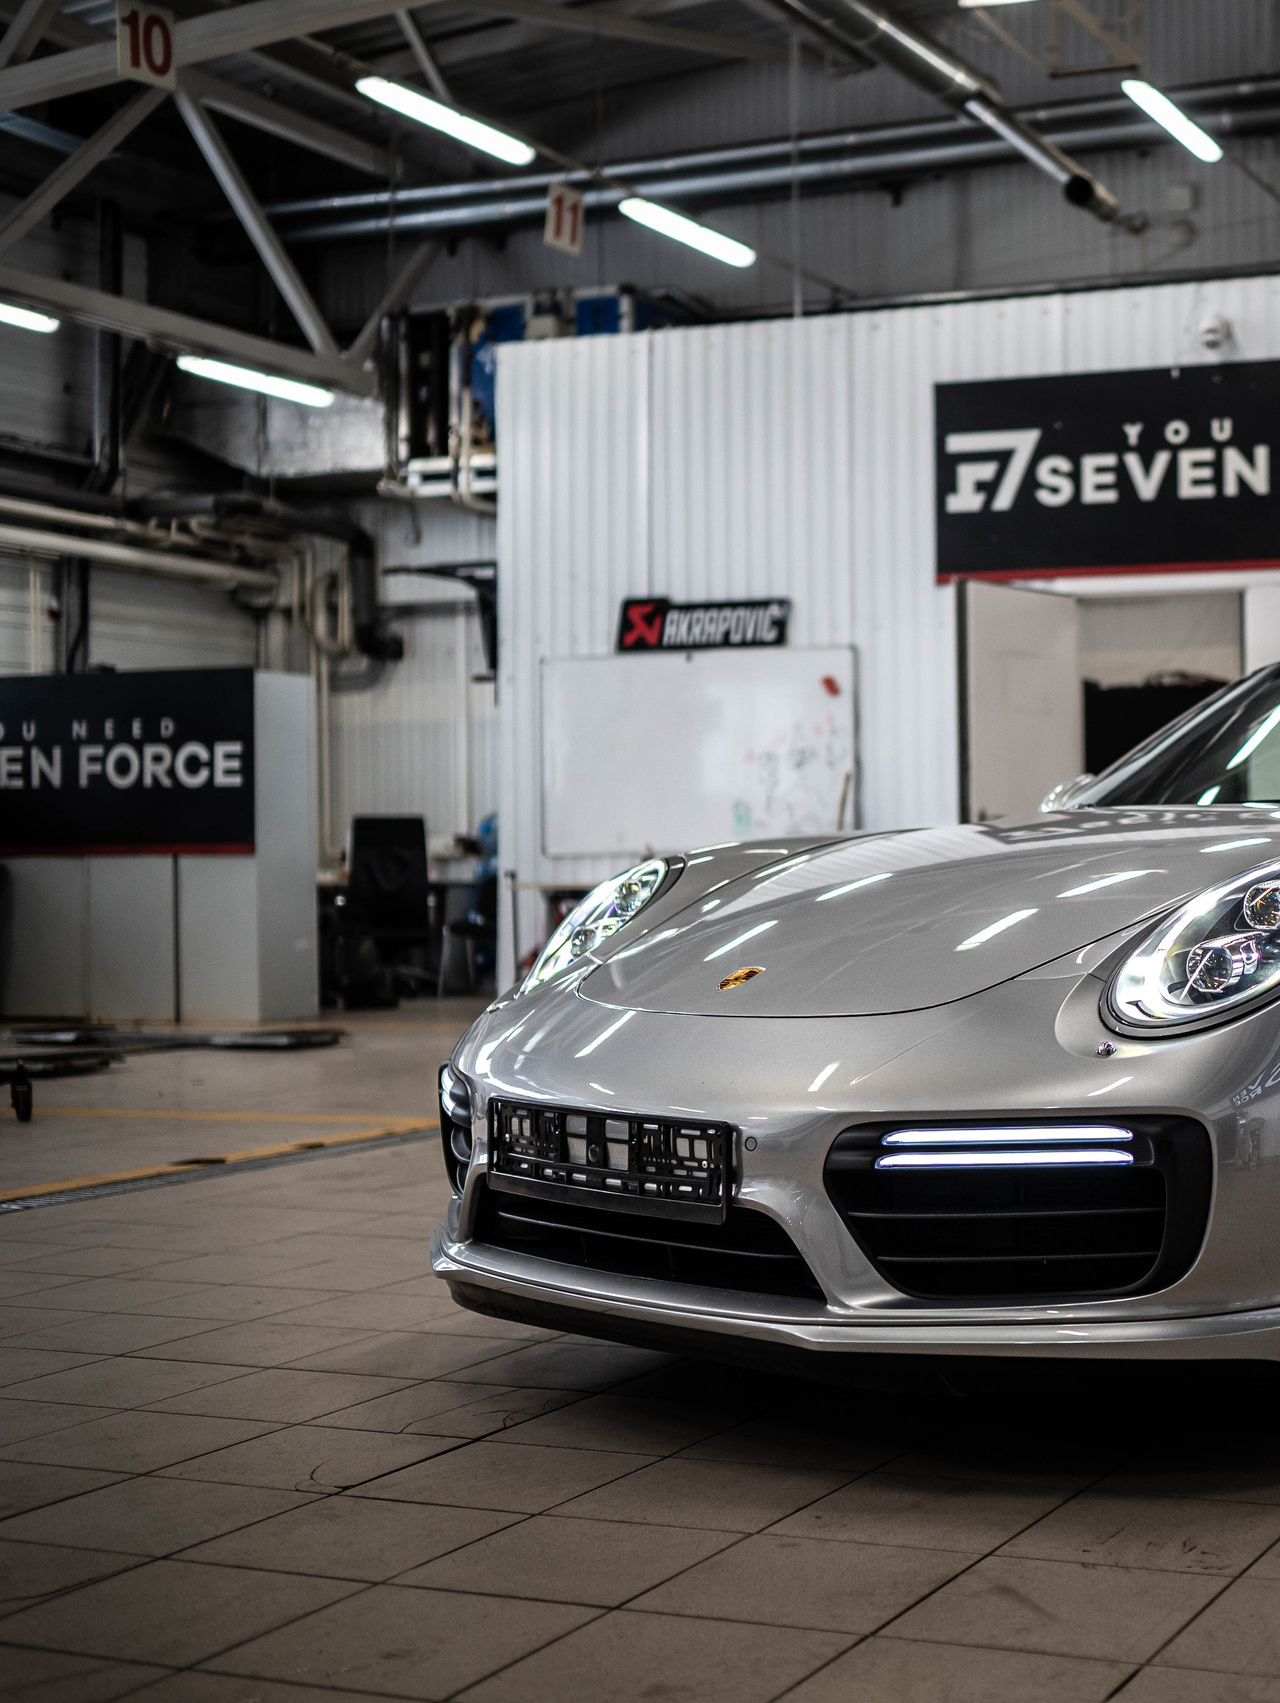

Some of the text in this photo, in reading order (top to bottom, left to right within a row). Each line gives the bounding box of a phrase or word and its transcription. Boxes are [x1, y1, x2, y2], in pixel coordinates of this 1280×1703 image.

[120, 8, 173, 76] 10
[549, 194, 579, 244] 11
[1122, 417, 1232, 446] YOU
[1034, 444, 1270, 507] SEVEN
[72, 717, 175, 740] NEED
[79, 740, 243, 788] FORCE
